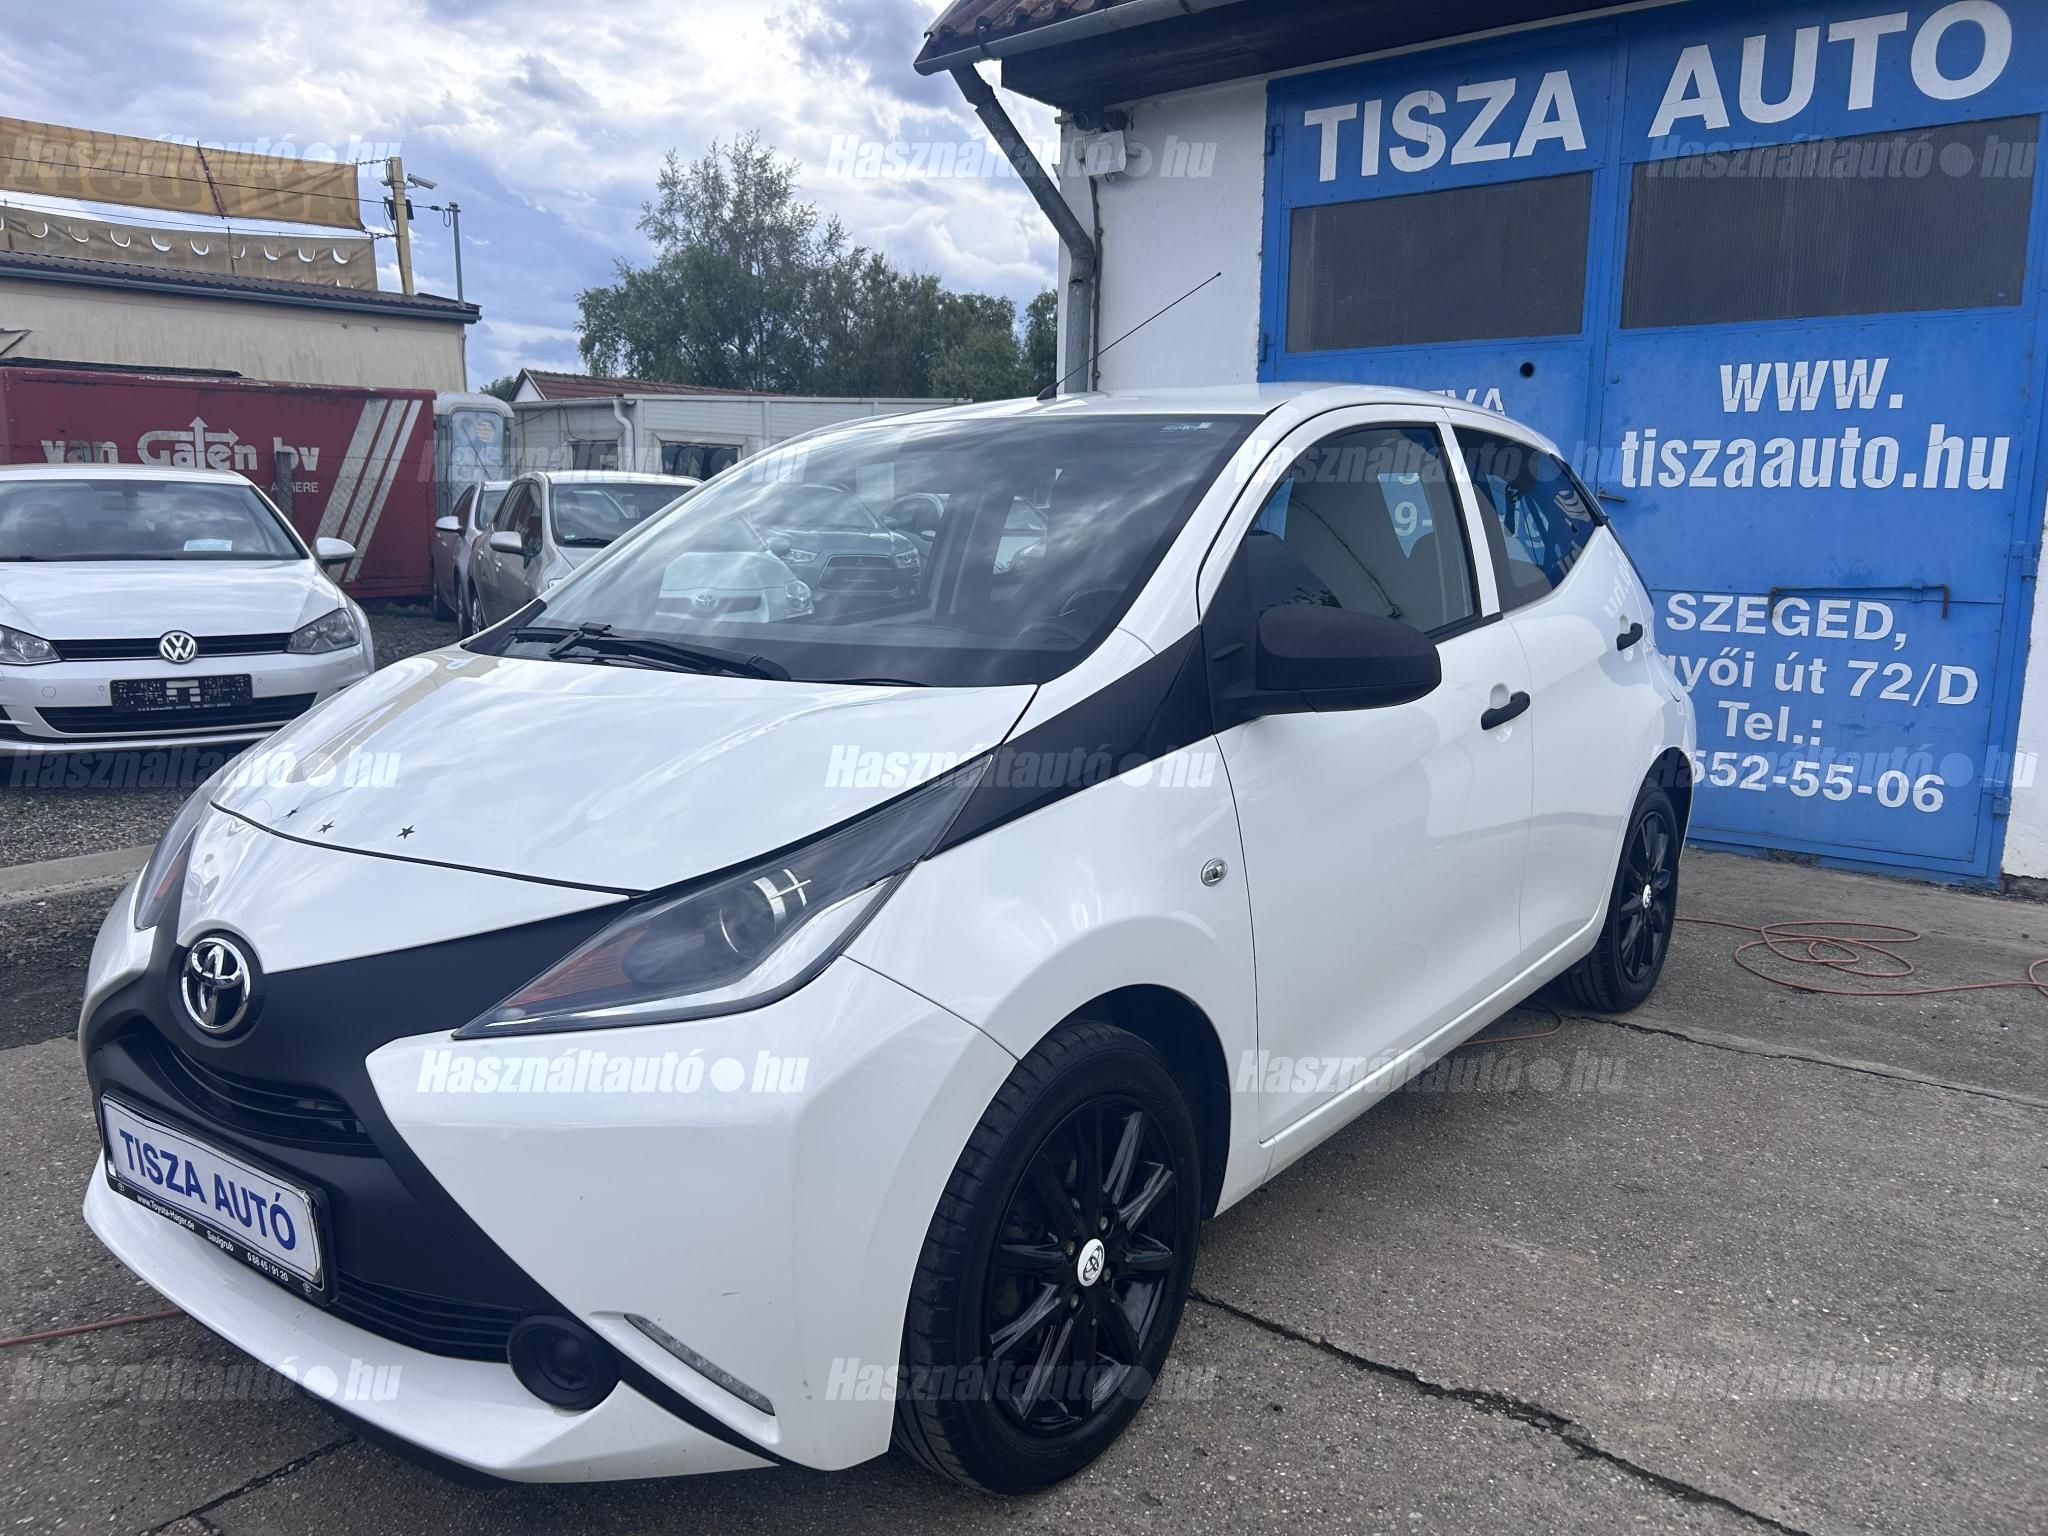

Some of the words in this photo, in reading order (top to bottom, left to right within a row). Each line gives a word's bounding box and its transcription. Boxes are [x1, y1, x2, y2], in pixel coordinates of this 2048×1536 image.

[1304, 70, 1588, 182] TISZA
[1648, 1, 2014, 138] AUTO
[1720, 357, 1904, 413] www.
[41, 440, 118, 463] van
[1620, 424, 2010, 490] tiszaauto.hu
[270, 481, 319, 493] AERE
[1665, 593, 1908, 650] SZEGED,
[1774, 652, 1826, 695] út
[1847, 660, 1979, 706] 72/D
[1718, 700, 1823, 746] Tel.:
[119, 1128, 207, 1204] TISZA
[214, 1173, 296, 1250] AUTÓ
